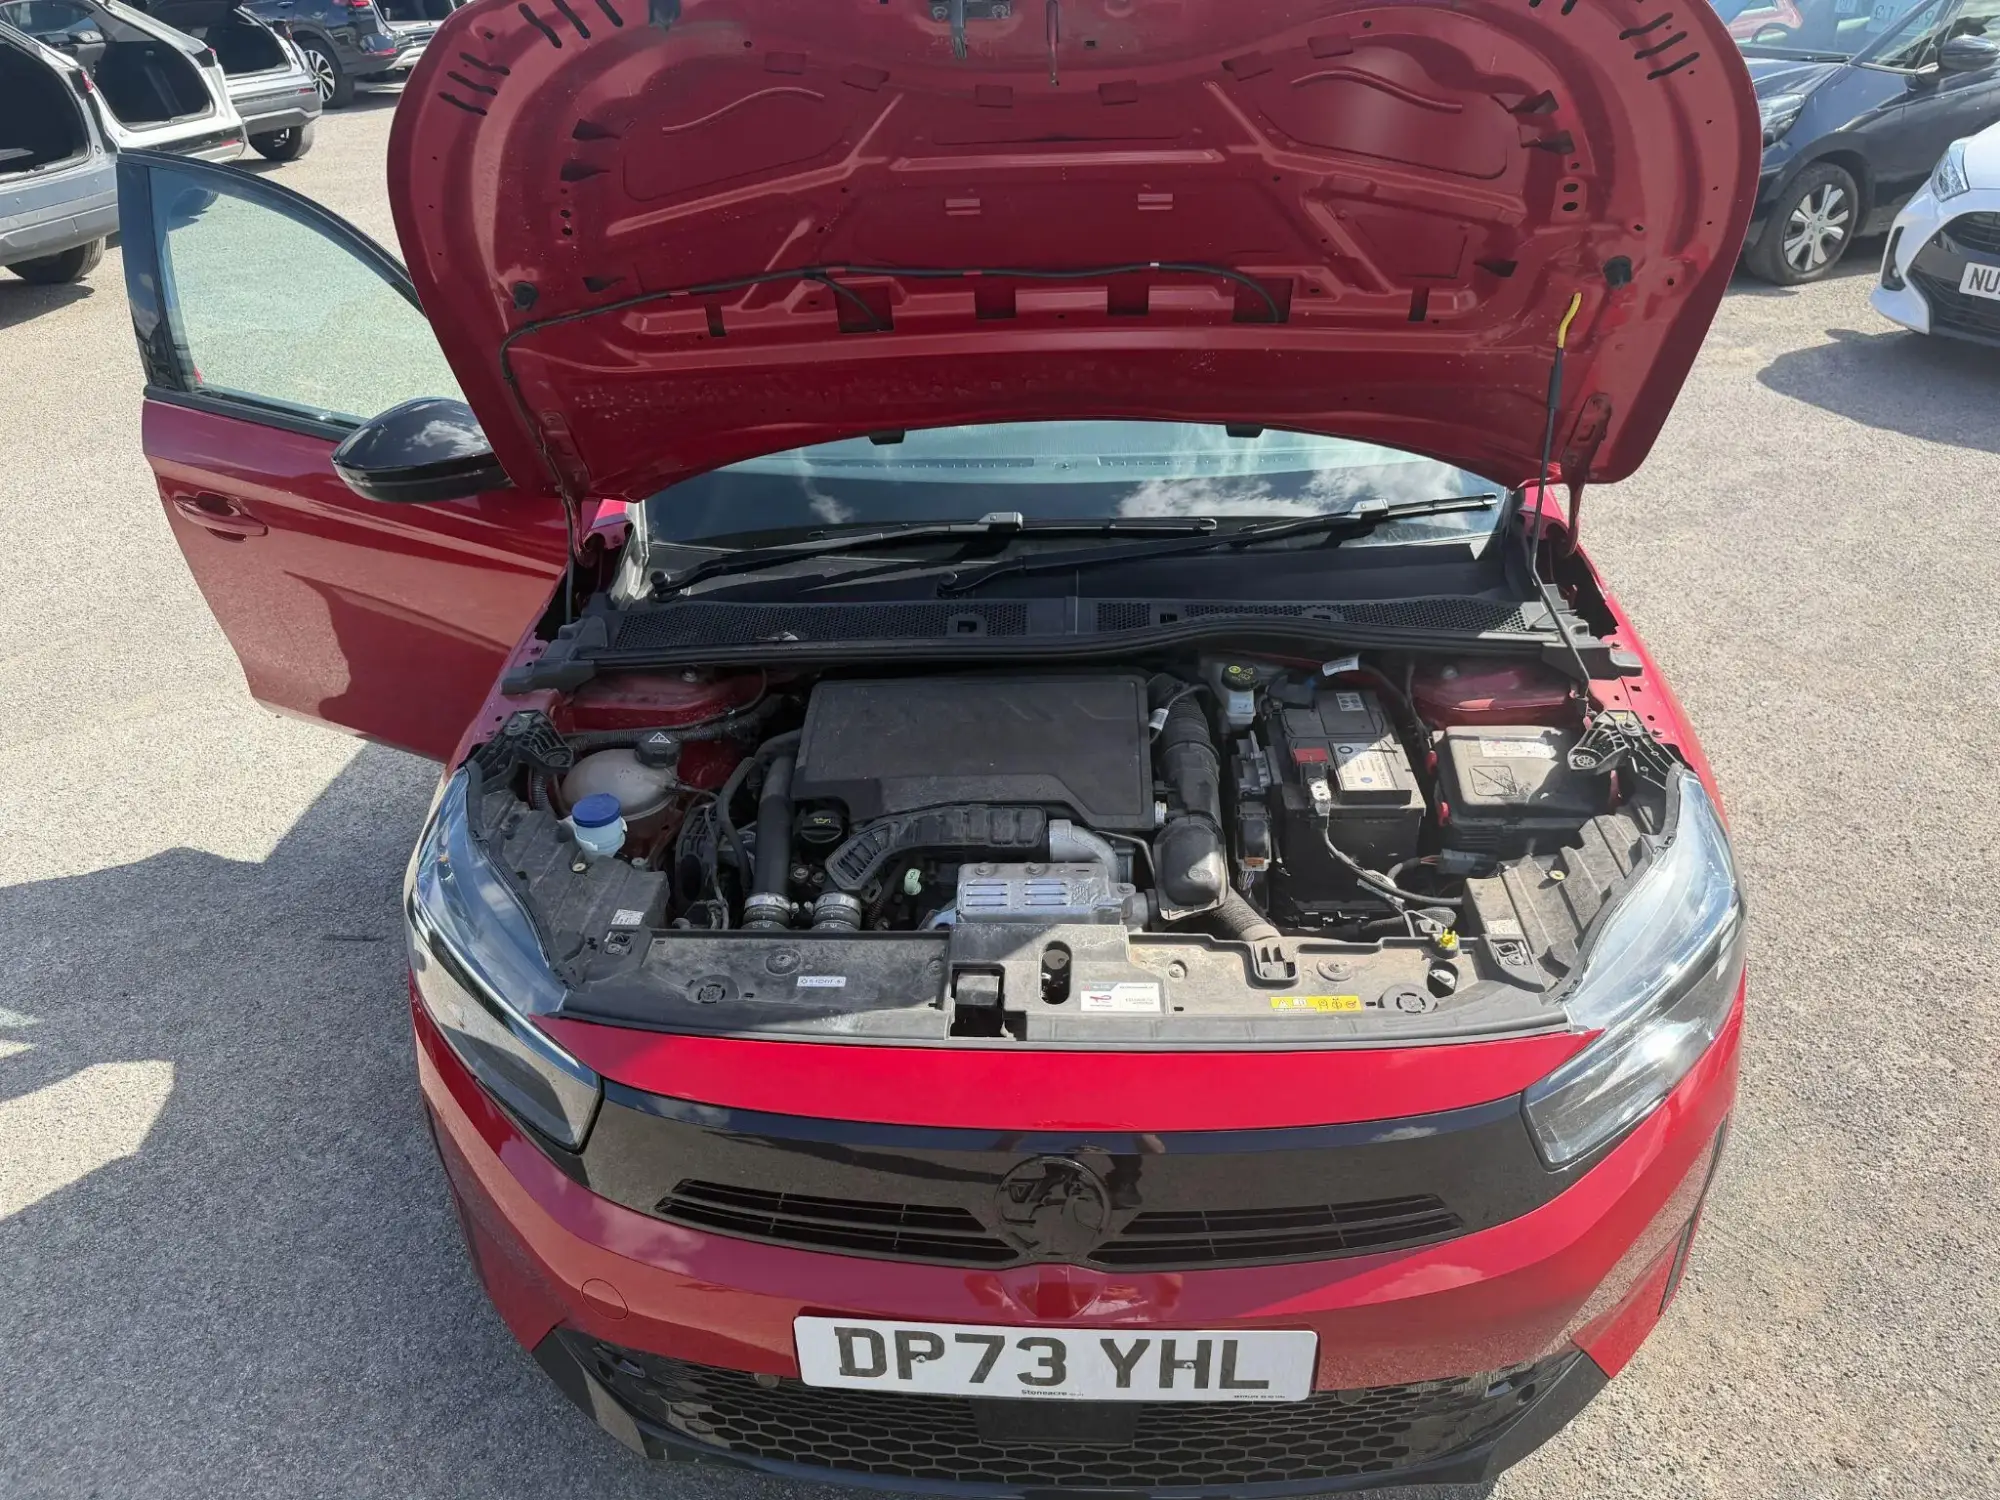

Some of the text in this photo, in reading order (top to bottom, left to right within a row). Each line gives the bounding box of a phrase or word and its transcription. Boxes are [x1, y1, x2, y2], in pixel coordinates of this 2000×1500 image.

[1968, 267, 2000, 294] NU
[834, 1326, 1269, 1389] DP73 YHL
